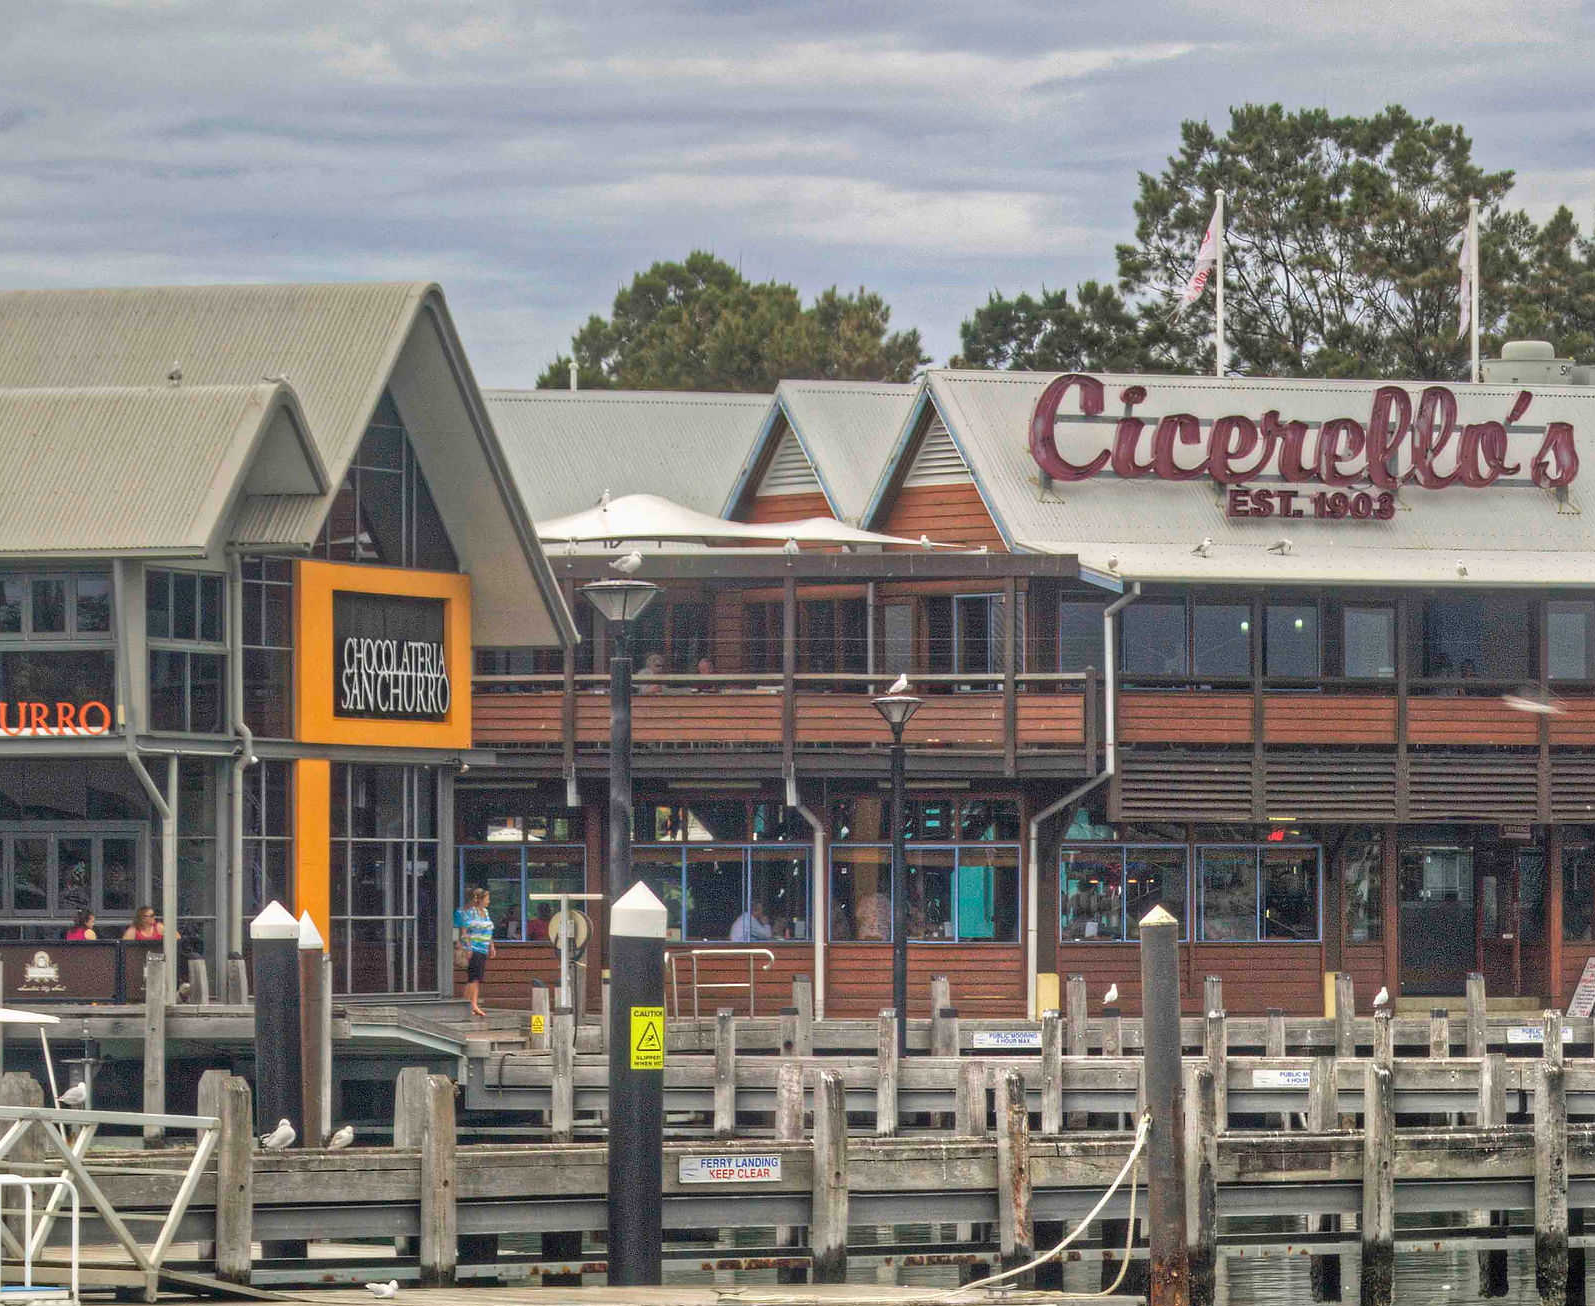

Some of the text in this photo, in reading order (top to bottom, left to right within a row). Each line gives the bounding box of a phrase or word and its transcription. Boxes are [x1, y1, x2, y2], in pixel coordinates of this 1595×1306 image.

[1028, 373, 1580, 490] Cicerello's
[1226, 489, 1395, 521] EST. 1903
[344, 637, 446, 678] CHOCOLATERIA
[341, 669, 450, 714] SAN CHURRO
[700, 1157, 778, 1168] FERRY LANDING
[709, 1168, 770, 1179] KEEP CLEAR
